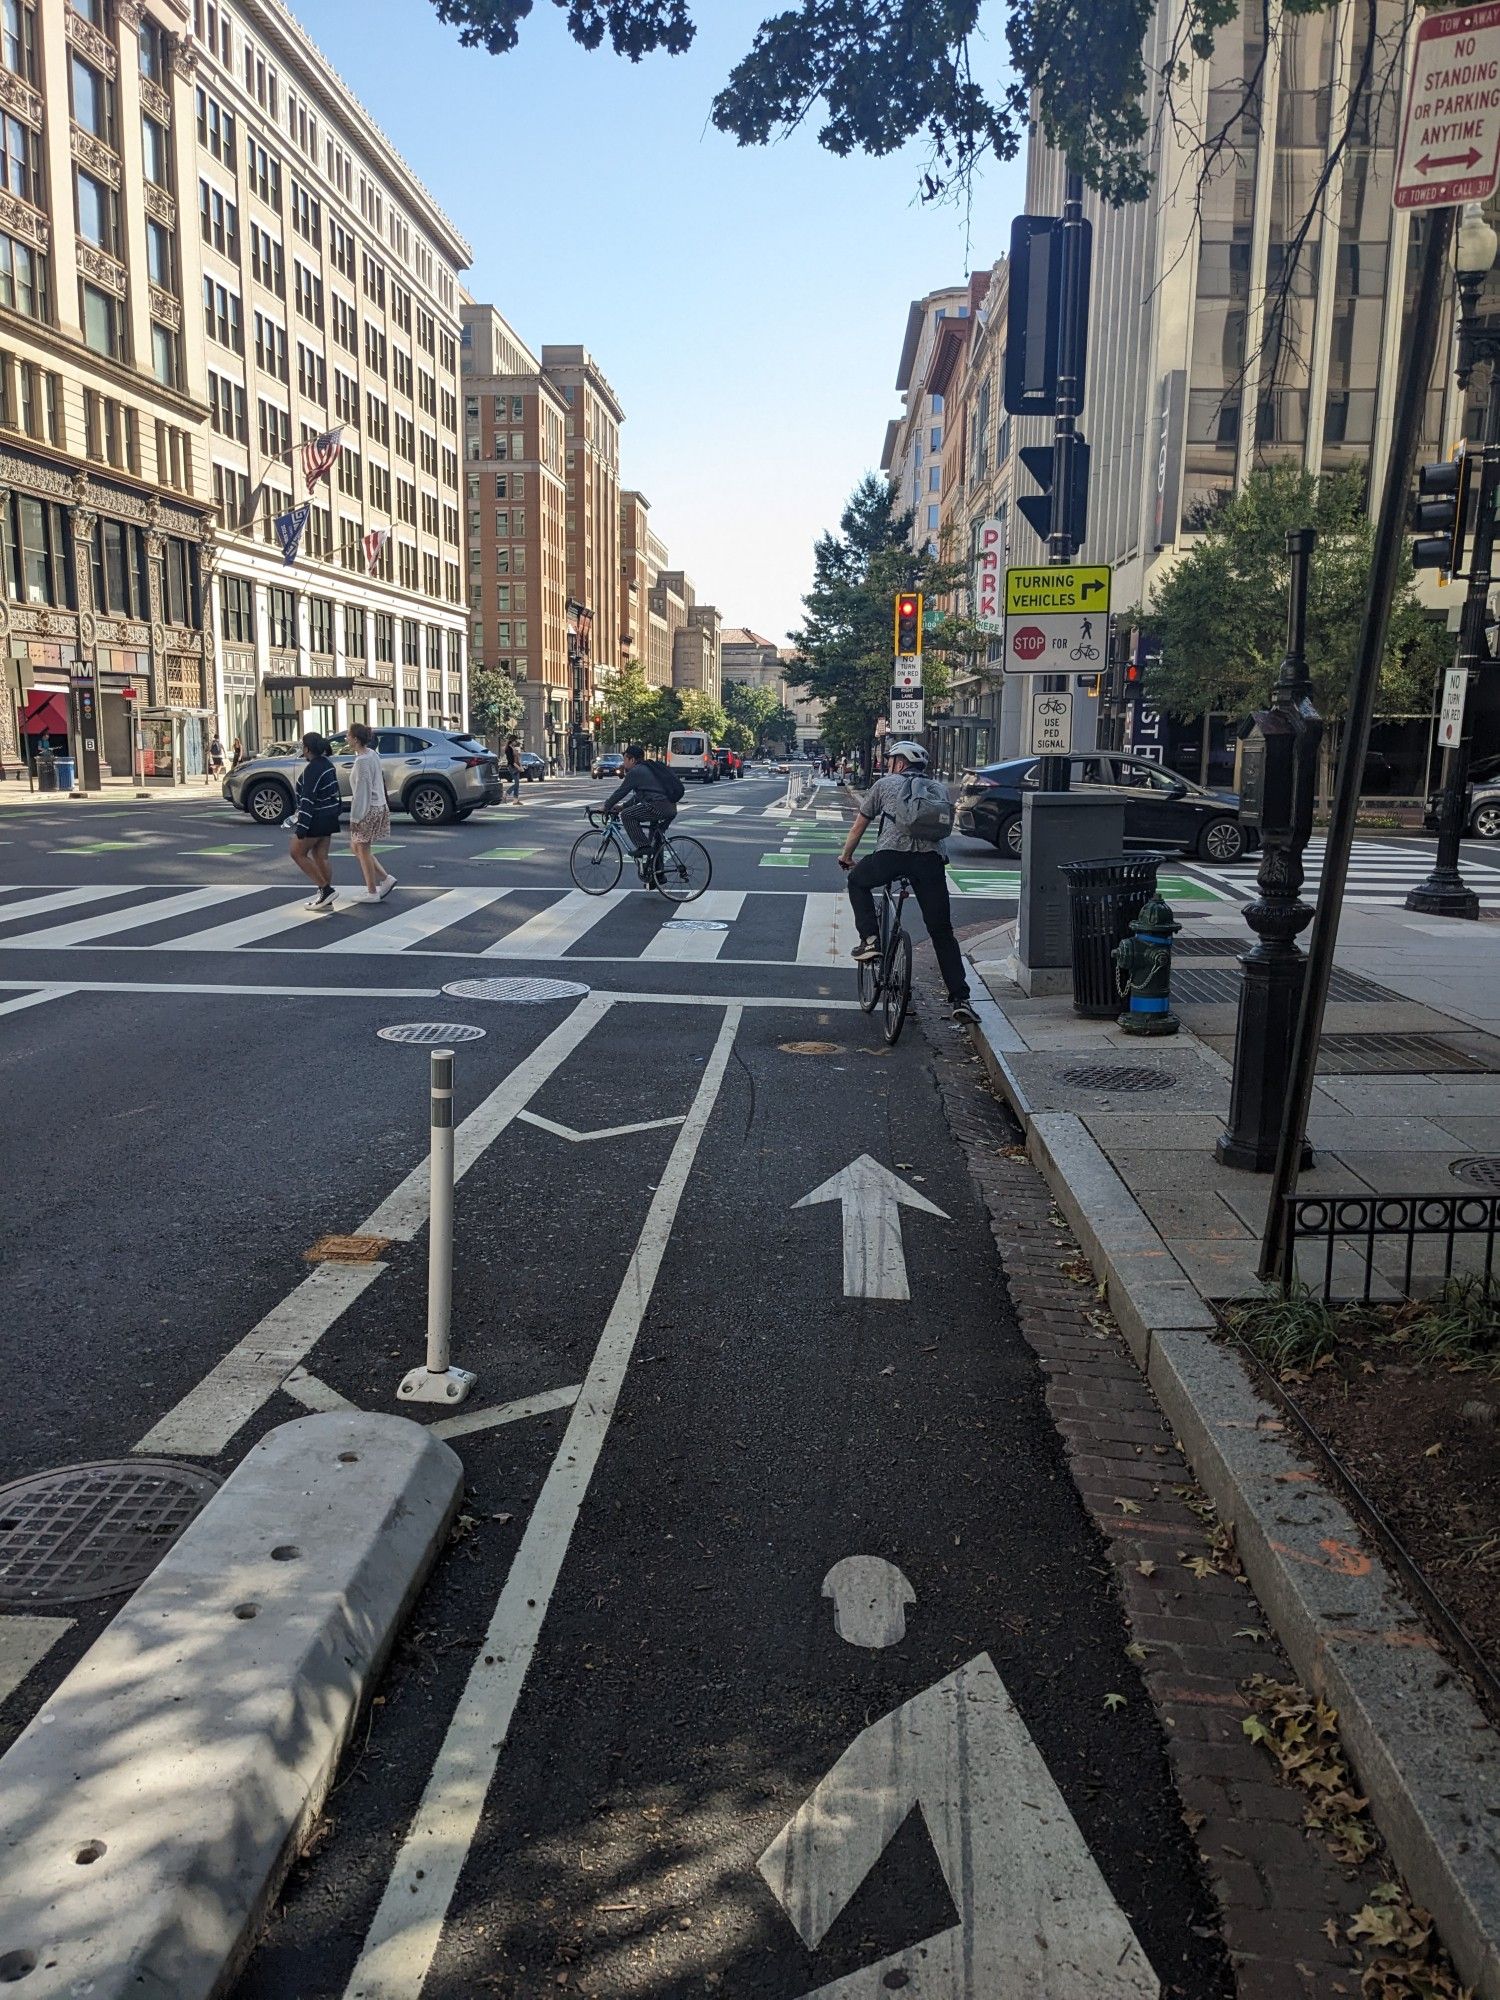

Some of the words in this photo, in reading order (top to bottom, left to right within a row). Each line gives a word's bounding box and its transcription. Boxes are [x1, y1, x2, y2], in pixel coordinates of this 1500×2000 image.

[1440, 17, 1460, 33] TOW
[1472, 8, 1499, 26] AWAY
[1454, 37, 1476, 58] NO
[1424, 60, 1498, 92] STANDING
[1414, 103, 1431, 120] OR
[1434, 88, 1499, 117] PARKING
[1420, 119, 1485, 146] ANYTIME
[1398, 190, 1408, 203] IF
[1410, 187, 1437, 201] TOWED
[1452, 182, 1473, 197] CALL
[1477, 180, 1490, 194] 311
[981, 529, 999, 615] PARK
[1015, 575, 1074, 588] TURNING
[1013, 594, 1075, 607] VEHICLES
[1015, 637, 1044, 650] STOP
[1052, 639, 1068, 649] FOR
[78, 662, 93, 677] M
[1450, 675, 1460, 689] NO
[1448, 693, 1461, 705] TURN
[1443, 709, 1450, 720] ON
[1450, 709, 1461, 721] RED
[1044, 718, 1060, 727] USE
[1044, 729, 1060, 737] PED
[86, 740, 94, 749] B
[1038, 740, 1065, 748] SIGNAL
